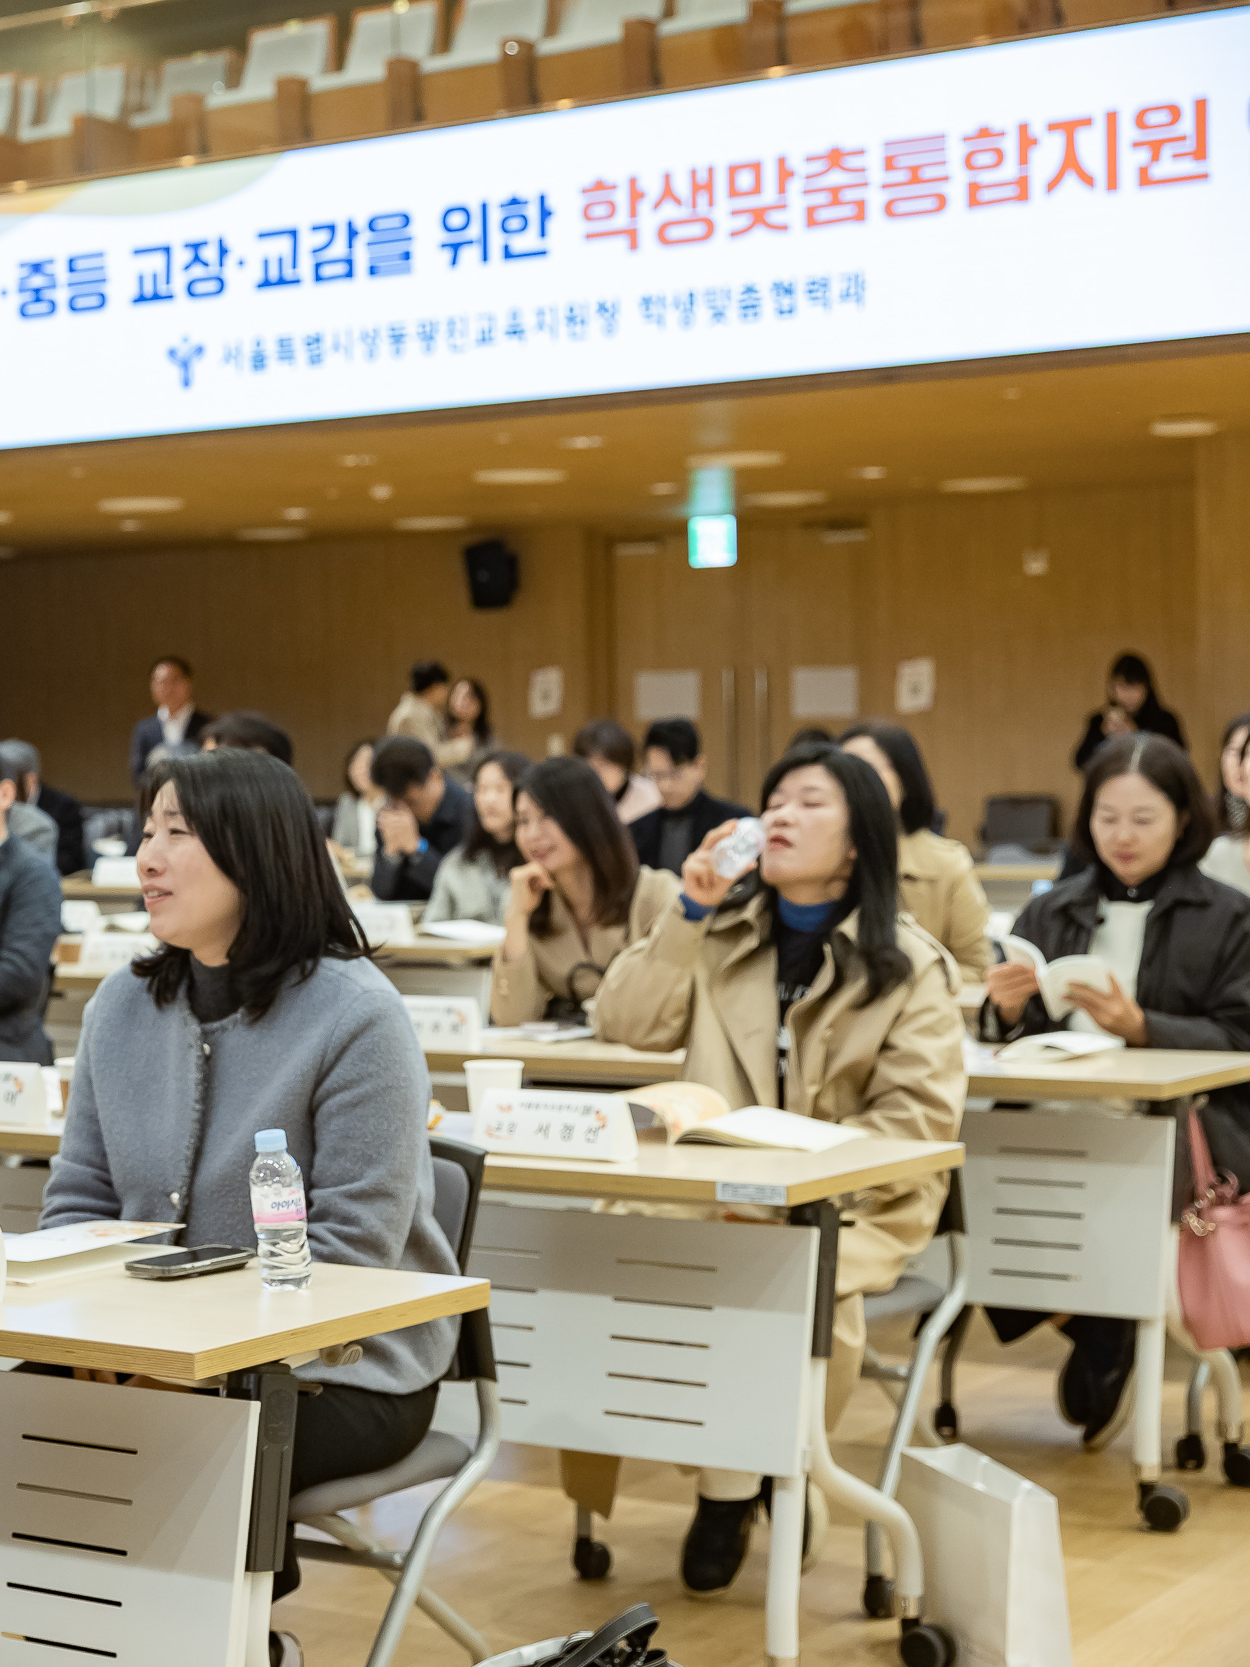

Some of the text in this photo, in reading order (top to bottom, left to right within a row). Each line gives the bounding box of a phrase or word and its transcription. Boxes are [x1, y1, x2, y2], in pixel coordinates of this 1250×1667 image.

[132, 212, 413, 305] 교장·교감을
[439, 194, 553, 267] 위한
[580, 97, 1210, 250] 학생맞춤통합지원
